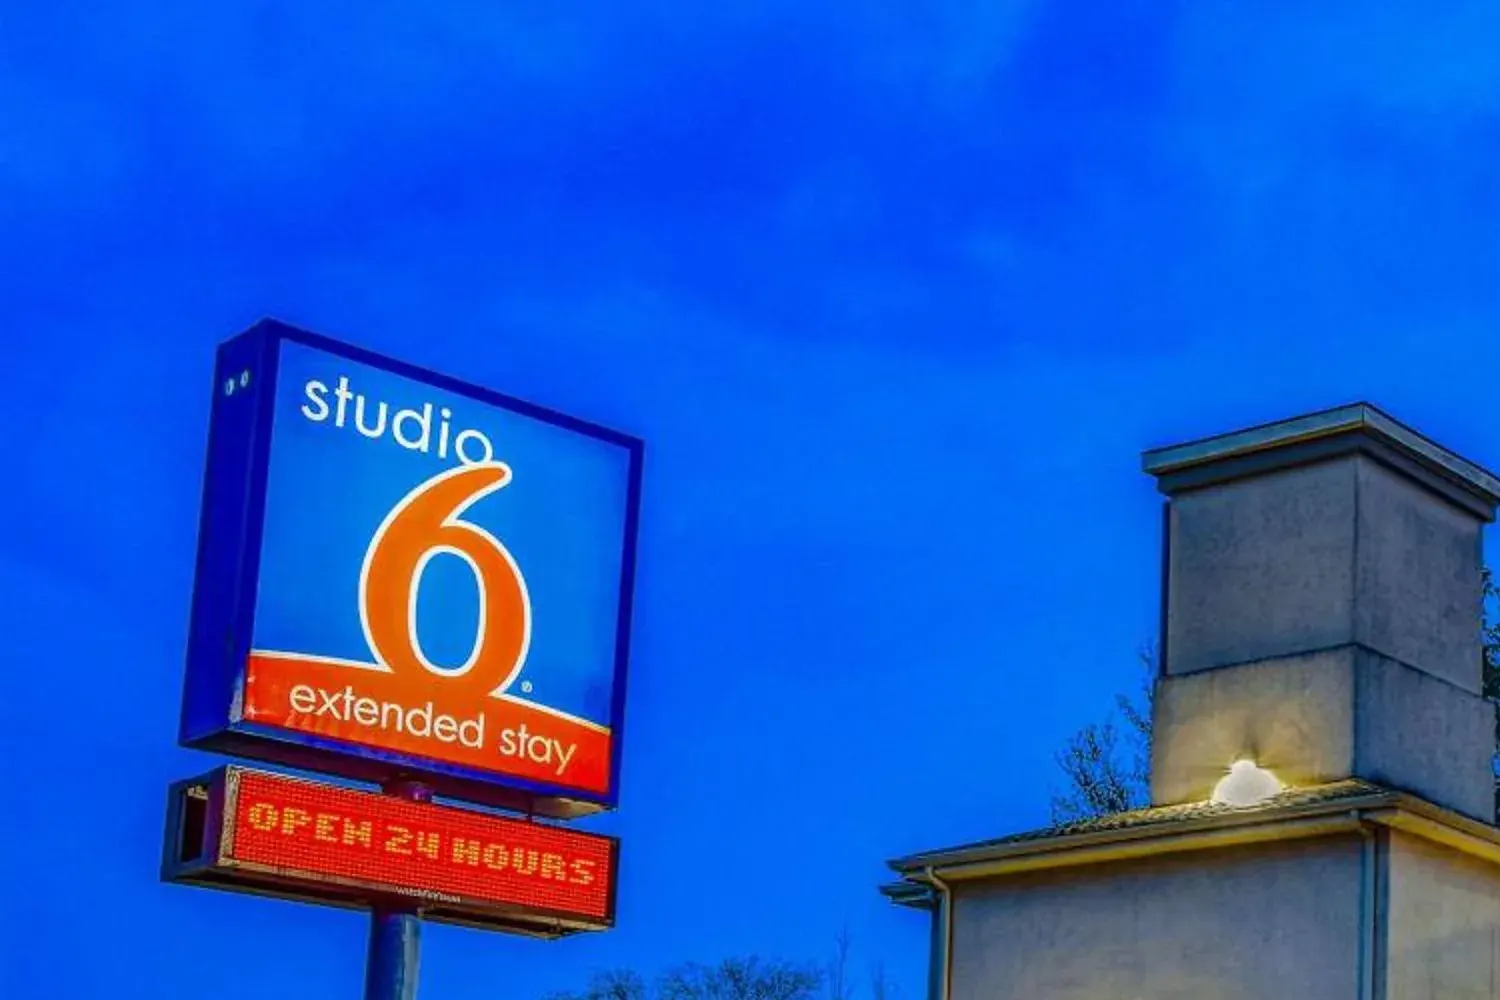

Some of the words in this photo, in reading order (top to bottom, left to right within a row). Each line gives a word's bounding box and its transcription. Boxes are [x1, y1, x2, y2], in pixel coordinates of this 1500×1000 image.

[301, 374, 494, 466] studio
[358, 459, 532, 699] 6
[289, 683, 485, 749] extended
[499, 723, 577, 776] stay
[249, 802, 373, 848] OPEN
[385, 823, 441, 860] 24
[451, 836, 597, 886] HOURS
